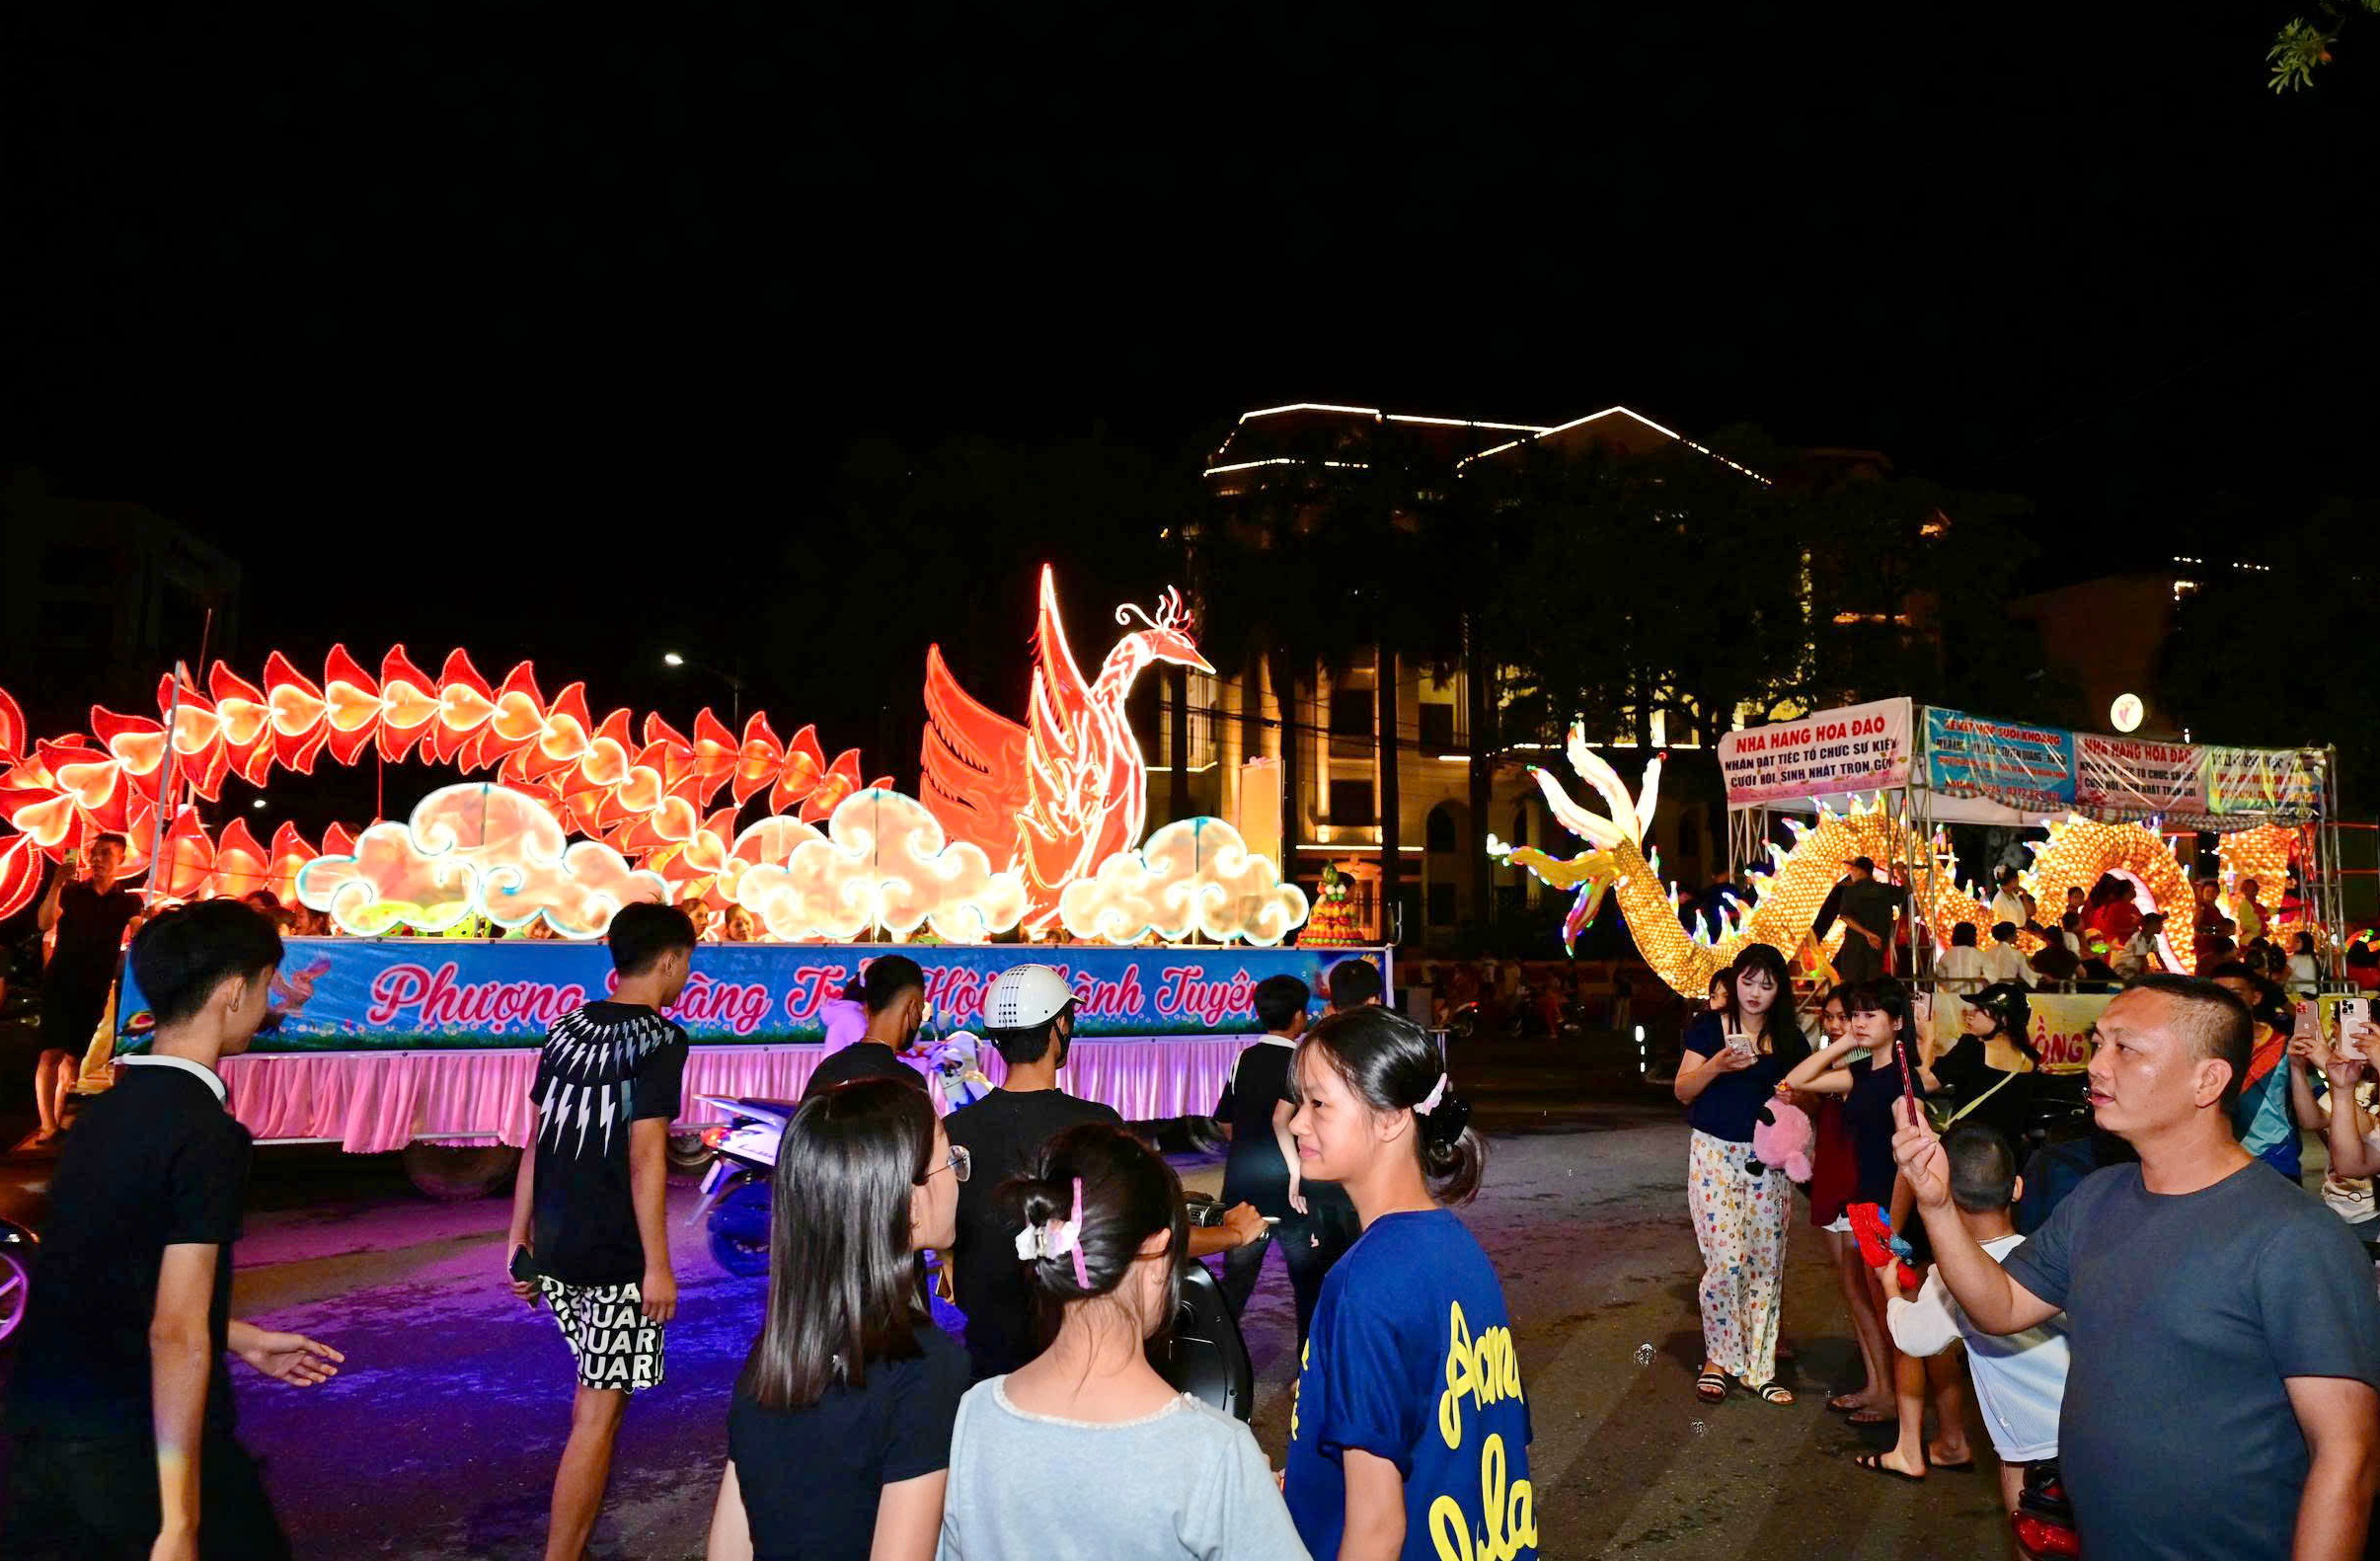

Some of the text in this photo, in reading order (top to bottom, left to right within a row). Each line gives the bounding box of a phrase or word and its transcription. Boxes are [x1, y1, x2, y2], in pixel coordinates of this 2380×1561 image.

[1815, 722, 1848, 741] HOA
[2144, 745, 2168, 762] HOA
[2032, 1014, 2084, 1064] ỒNG
